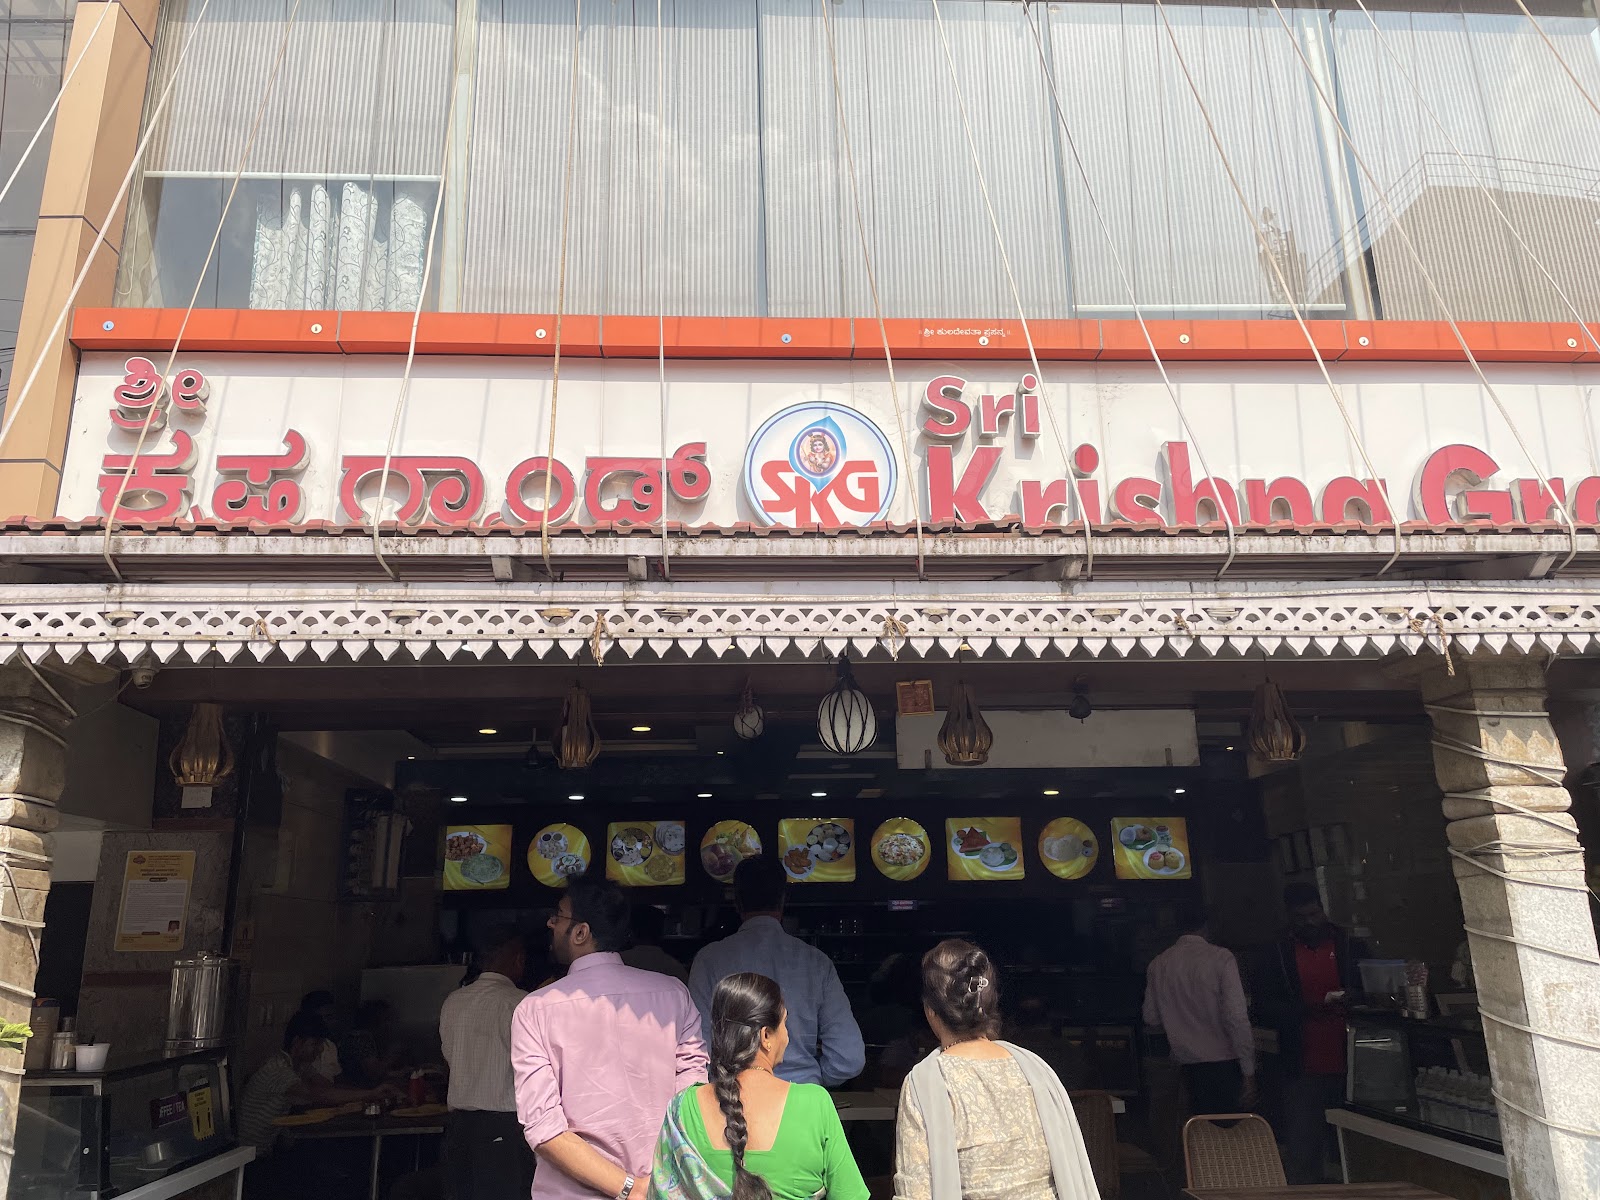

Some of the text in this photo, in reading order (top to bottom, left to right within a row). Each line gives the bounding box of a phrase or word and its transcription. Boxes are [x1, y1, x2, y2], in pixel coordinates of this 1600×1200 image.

[109, 356, 207, 430] ಶ್ರೀ
[923, 373, 1041, 437] Sri
[760, 459, 880, 527] SKG
[926, 440, 1394, 525] Krishna
